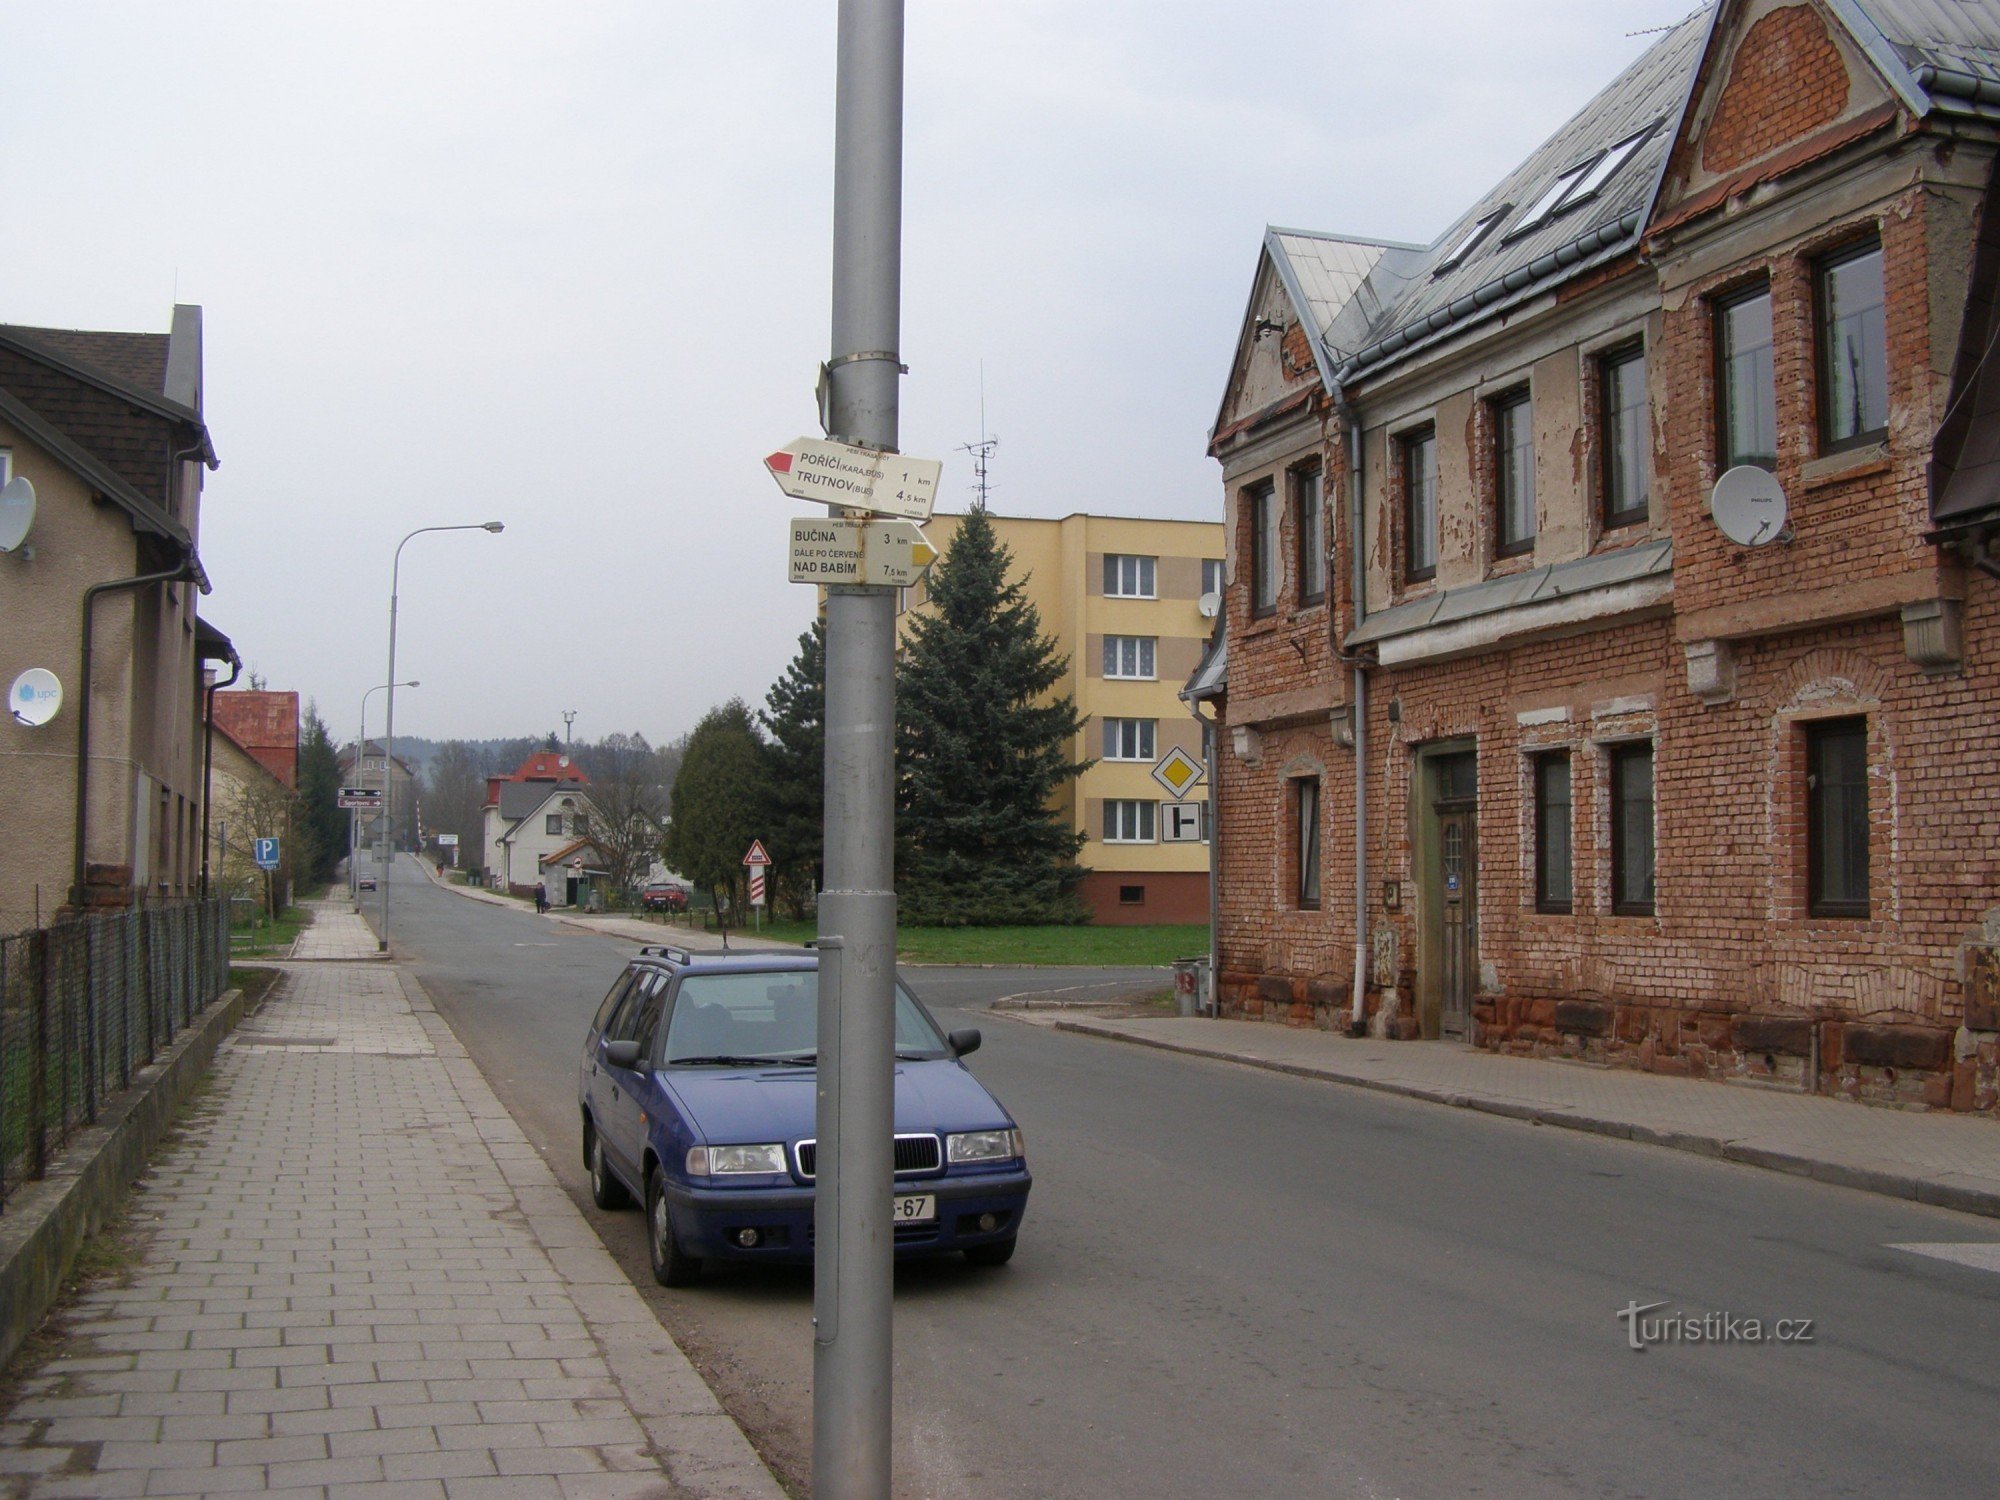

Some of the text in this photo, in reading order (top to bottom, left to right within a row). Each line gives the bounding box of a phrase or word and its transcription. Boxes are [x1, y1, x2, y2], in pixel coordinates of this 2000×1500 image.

[902, 472, 908, 482] 1
[917, 477, 931, 486] km
[913, 495, 927, 504] km
[795, 528, 837, 542] BUČINA
[884, 533, 891, 544] 3
[794, 547, 815, 557] DÁLE
[816, 549, 827, 558] PO
[793, 560, 908, 577] NAD BABÍM 7,5 km
[38, 690, 57, 701] upc
[262, 840, 273, 860] P
